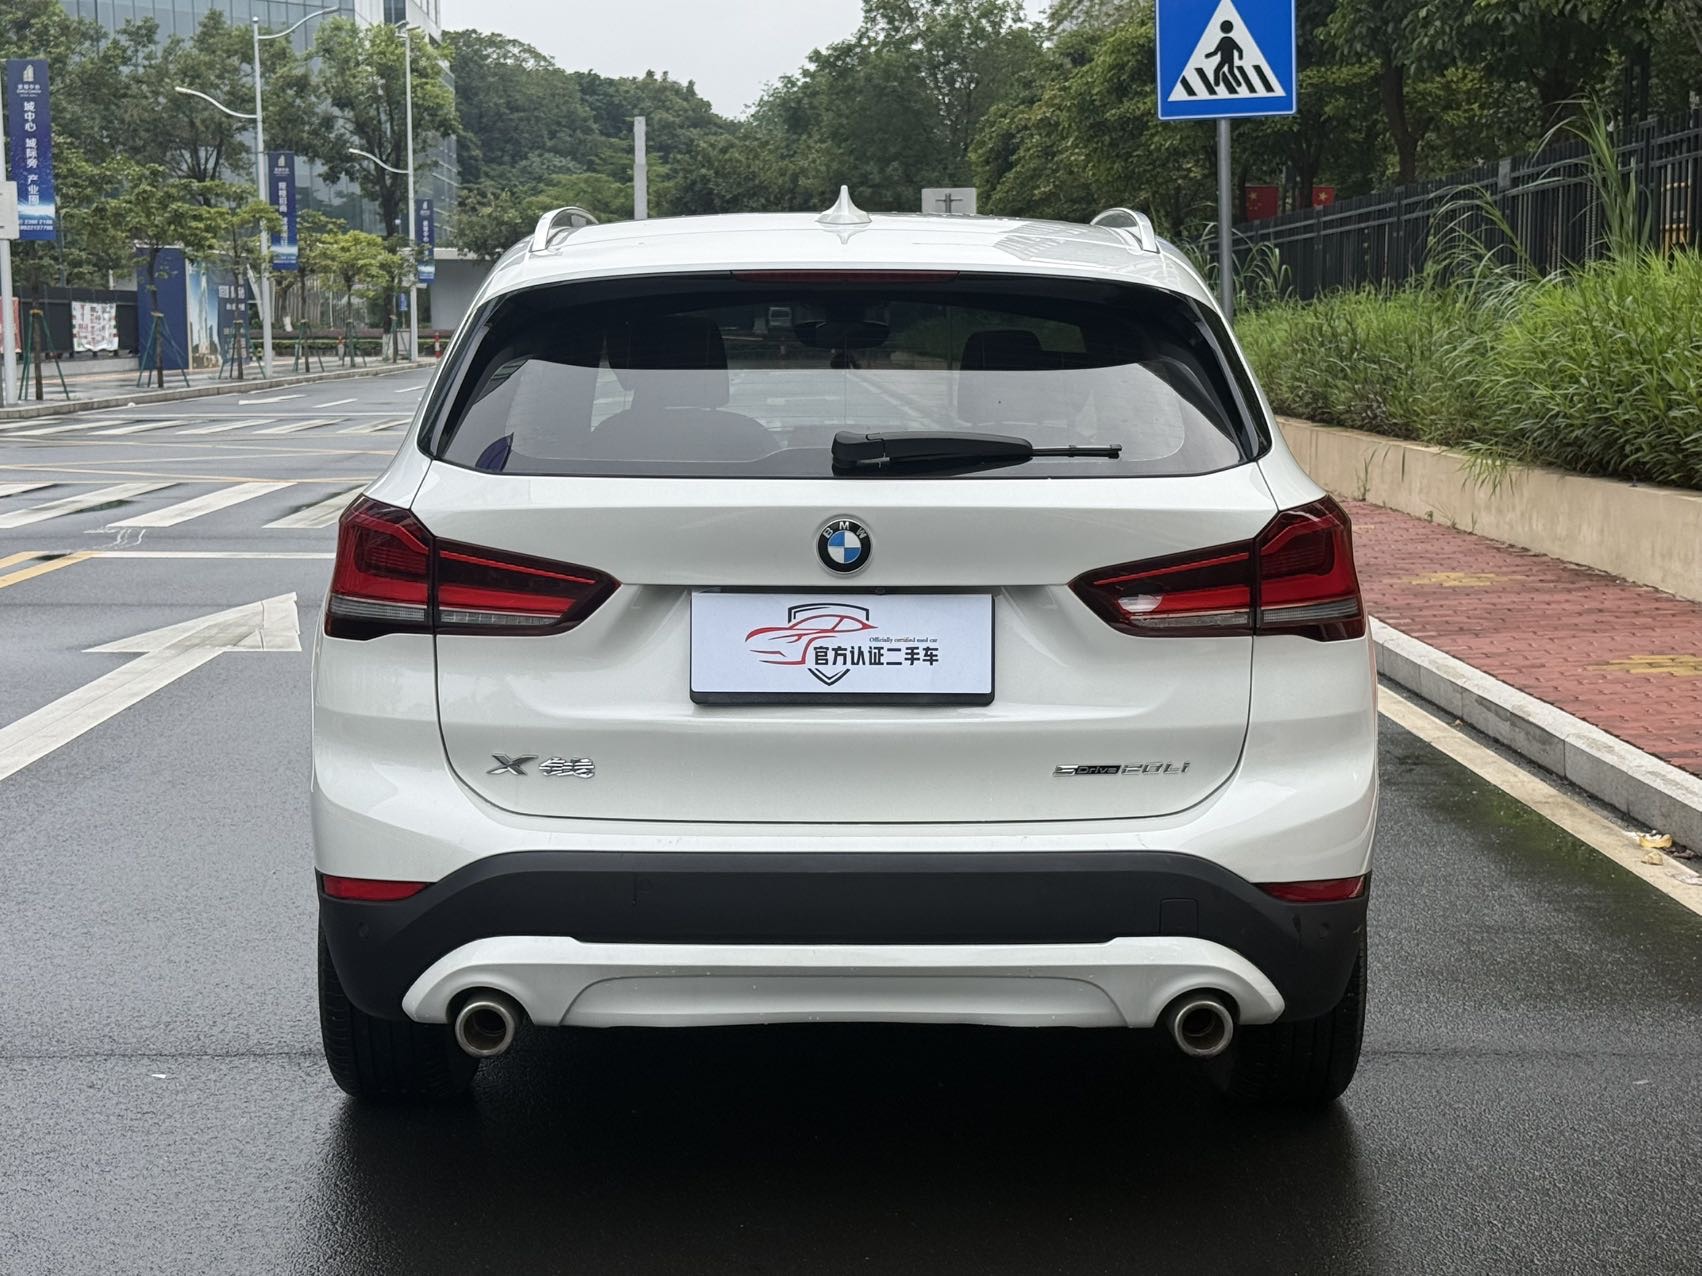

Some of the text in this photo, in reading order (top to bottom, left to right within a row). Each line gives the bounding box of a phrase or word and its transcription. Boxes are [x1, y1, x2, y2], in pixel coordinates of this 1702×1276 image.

[822, 521, 868, 539] BMW
[869, 636, 893, 644] Officially
[813, 646, 939, 666] 官方认证二手车
